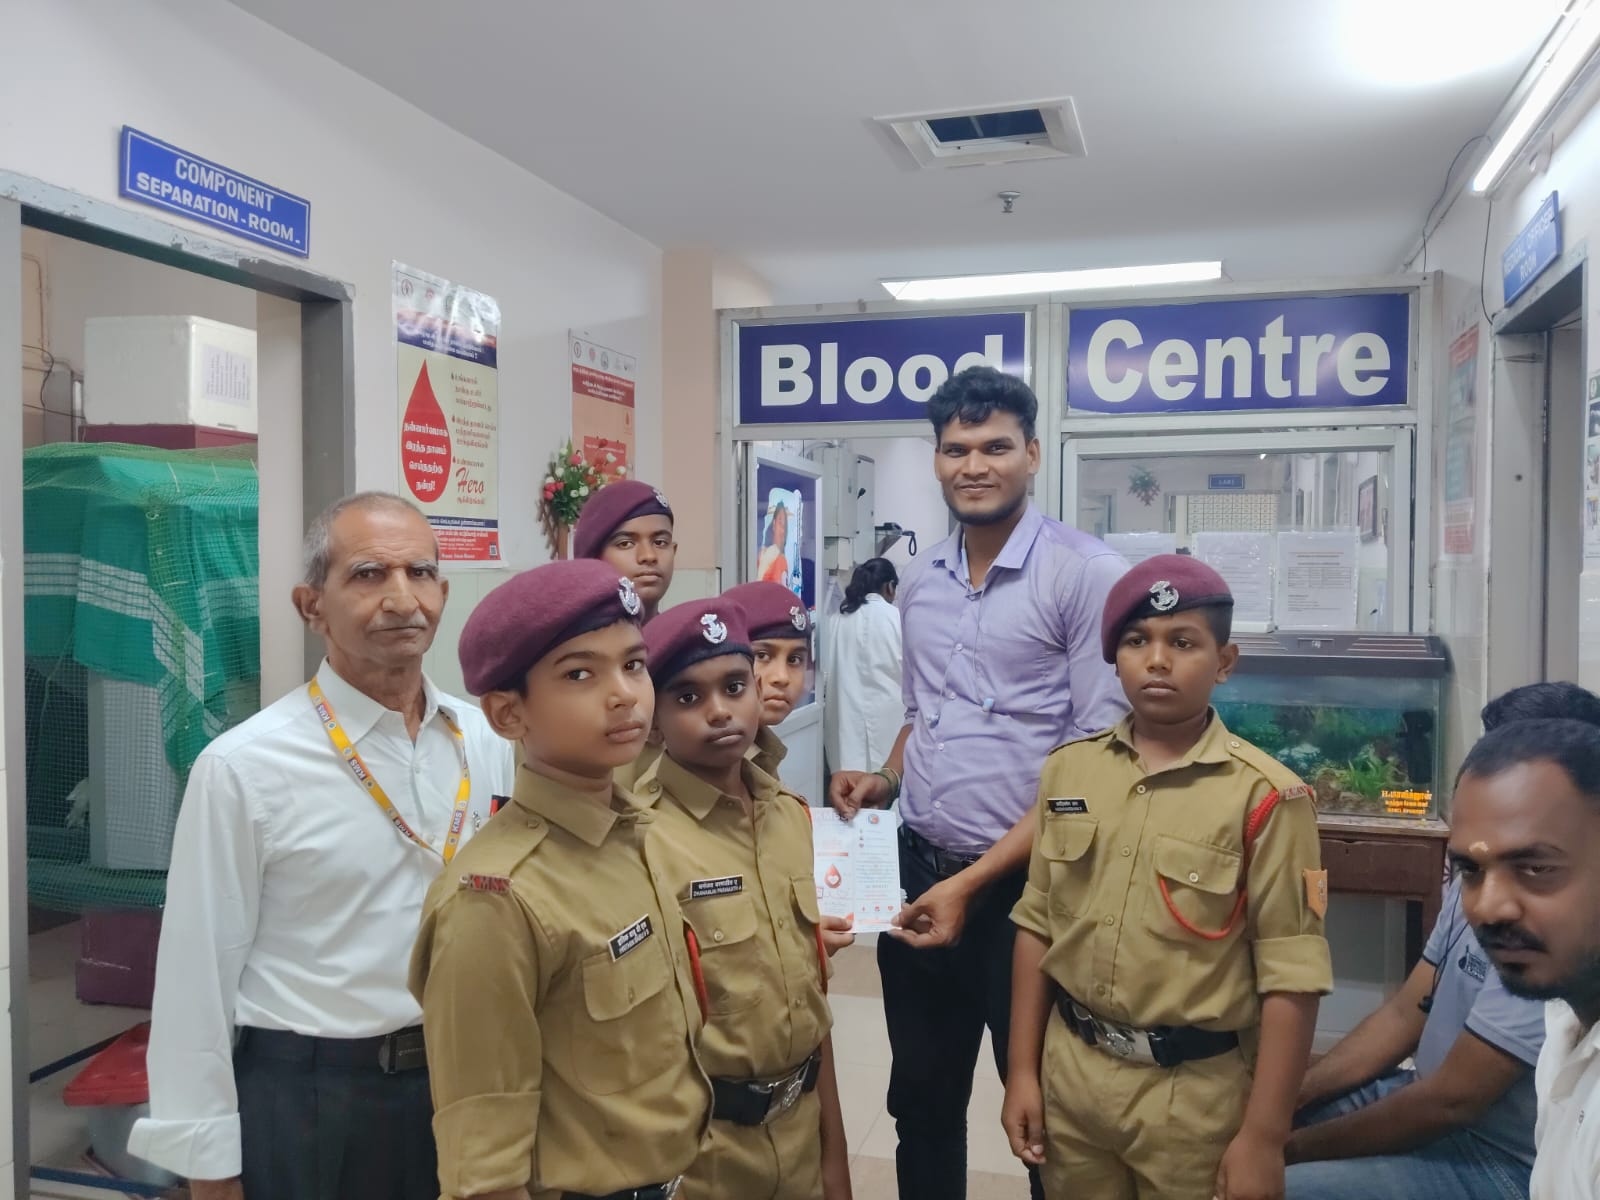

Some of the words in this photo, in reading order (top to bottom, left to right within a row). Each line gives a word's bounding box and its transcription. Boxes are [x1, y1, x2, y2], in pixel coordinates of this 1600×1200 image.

[175, 158, 275, 212] COMPONENT
[1087, 314, 1391, 403] Centre
[455, 466, 485, 494] Hero
[317, 704, 331, 722] KMS
[350, 758, 366, 781] KMS
[451, 811, 463, 833] KMS
